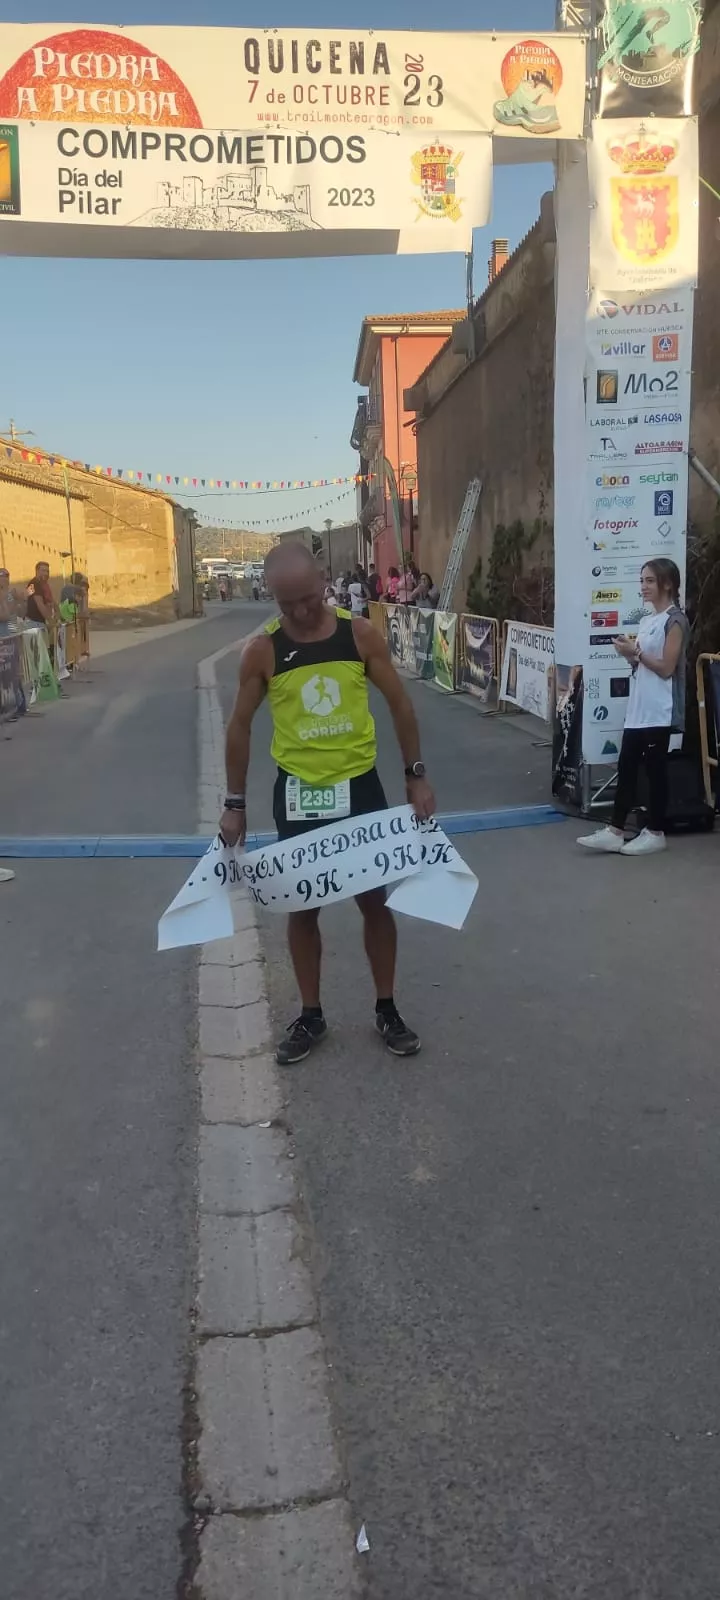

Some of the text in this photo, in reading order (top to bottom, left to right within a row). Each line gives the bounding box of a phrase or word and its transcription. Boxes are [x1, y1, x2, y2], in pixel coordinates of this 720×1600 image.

[32, 46, 161, 87] PIEDRA
[243, 37, 391, 75] QUICENA
[405, 53, 424, 73] 20
[16, 83, 180, 122] A PIEDRA
[247, 79, 391, 106] 7 de OCTUBRE
[403, 73, 444, 108] 23
[256, 109, 434, 126] www.trailmontearagon.com
[57, 127, 367, 166] COMPROMETIDOS
[58, 167, 123, 189] Día del
[58, 189, 122, 216] Pilar
[327, 187, 376, 207] 2023
[621, 302, 685, 317] VIDAL
[612, 340, 647, 355] villar
[590, 417, 627, 427] LABORAL
[593, 517, 640, 532] fotoprix
[510, 627, 555, 654] COMPROMETIDOS
[299, 722, 354, 741] CORRER
[302, 790, 334, 807] 239
[291, 821, 386, 869] PIEDRA
[389, 817, 408, 835] A
[296, 868, 343, 903] 9K
[374, 843, 419, 877] 9K
